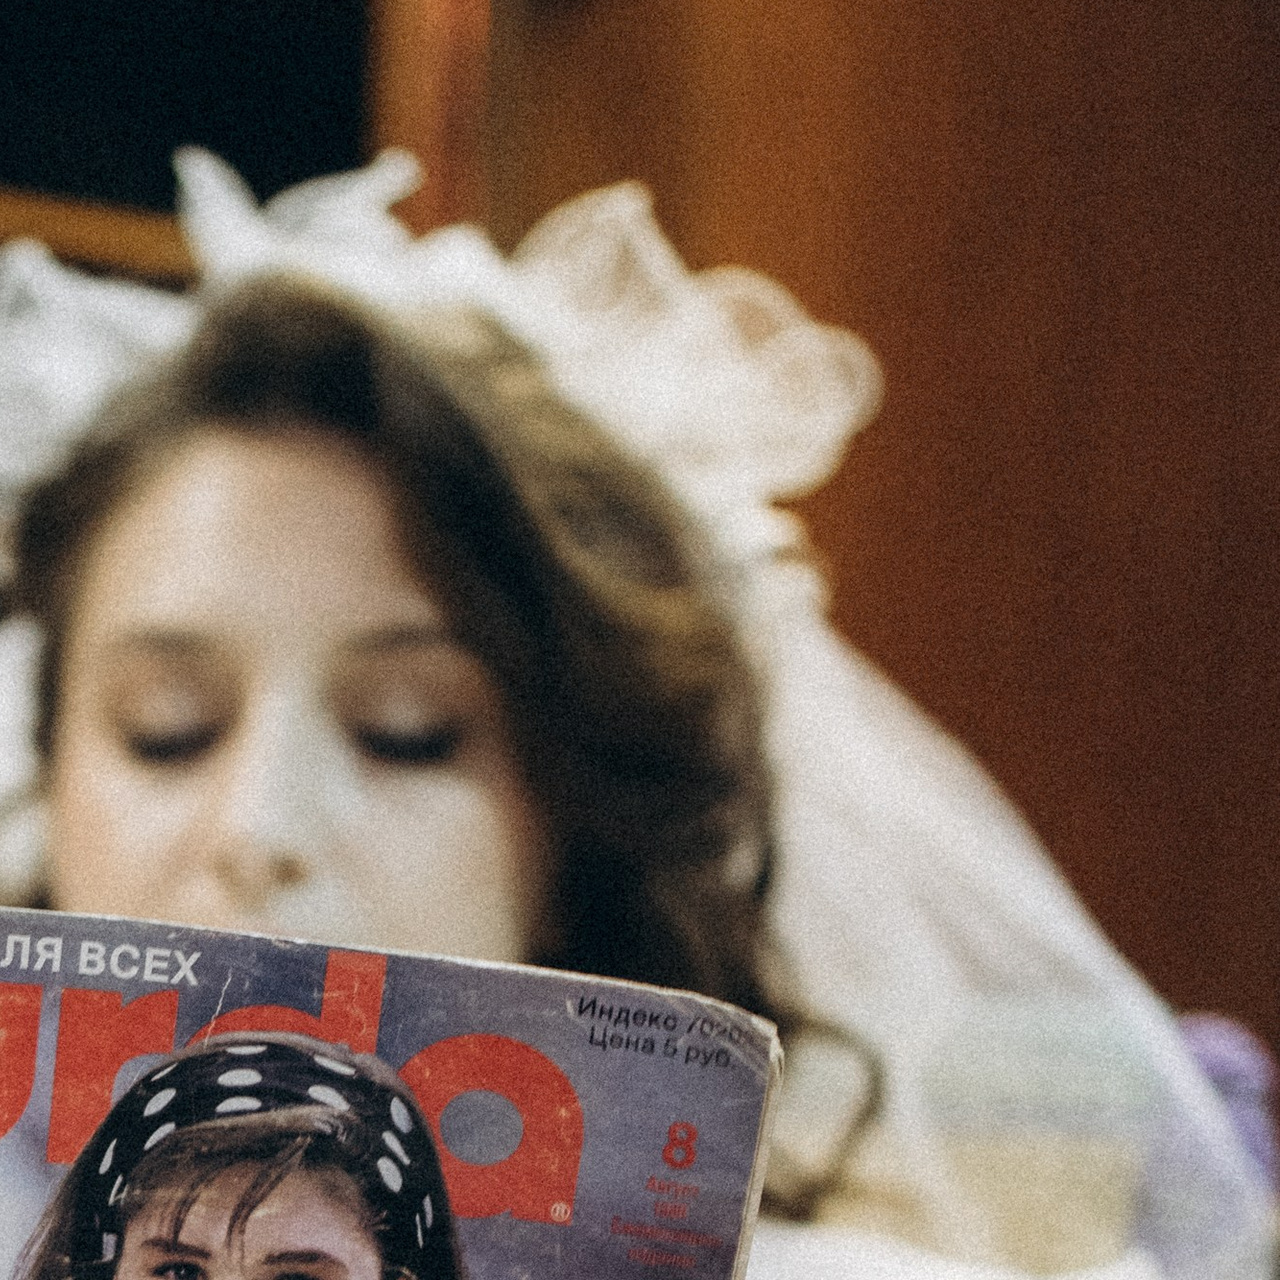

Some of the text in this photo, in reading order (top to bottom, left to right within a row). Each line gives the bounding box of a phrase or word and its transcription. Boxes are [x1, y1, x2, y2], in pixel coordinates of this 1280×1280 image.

[78, 941, 200, 986] ВСЕХ
[578, 997, 677, 1032] Индекс
[589, 1024, 655, 1056] Цена
[662, 1120, 698, 1170] 8
